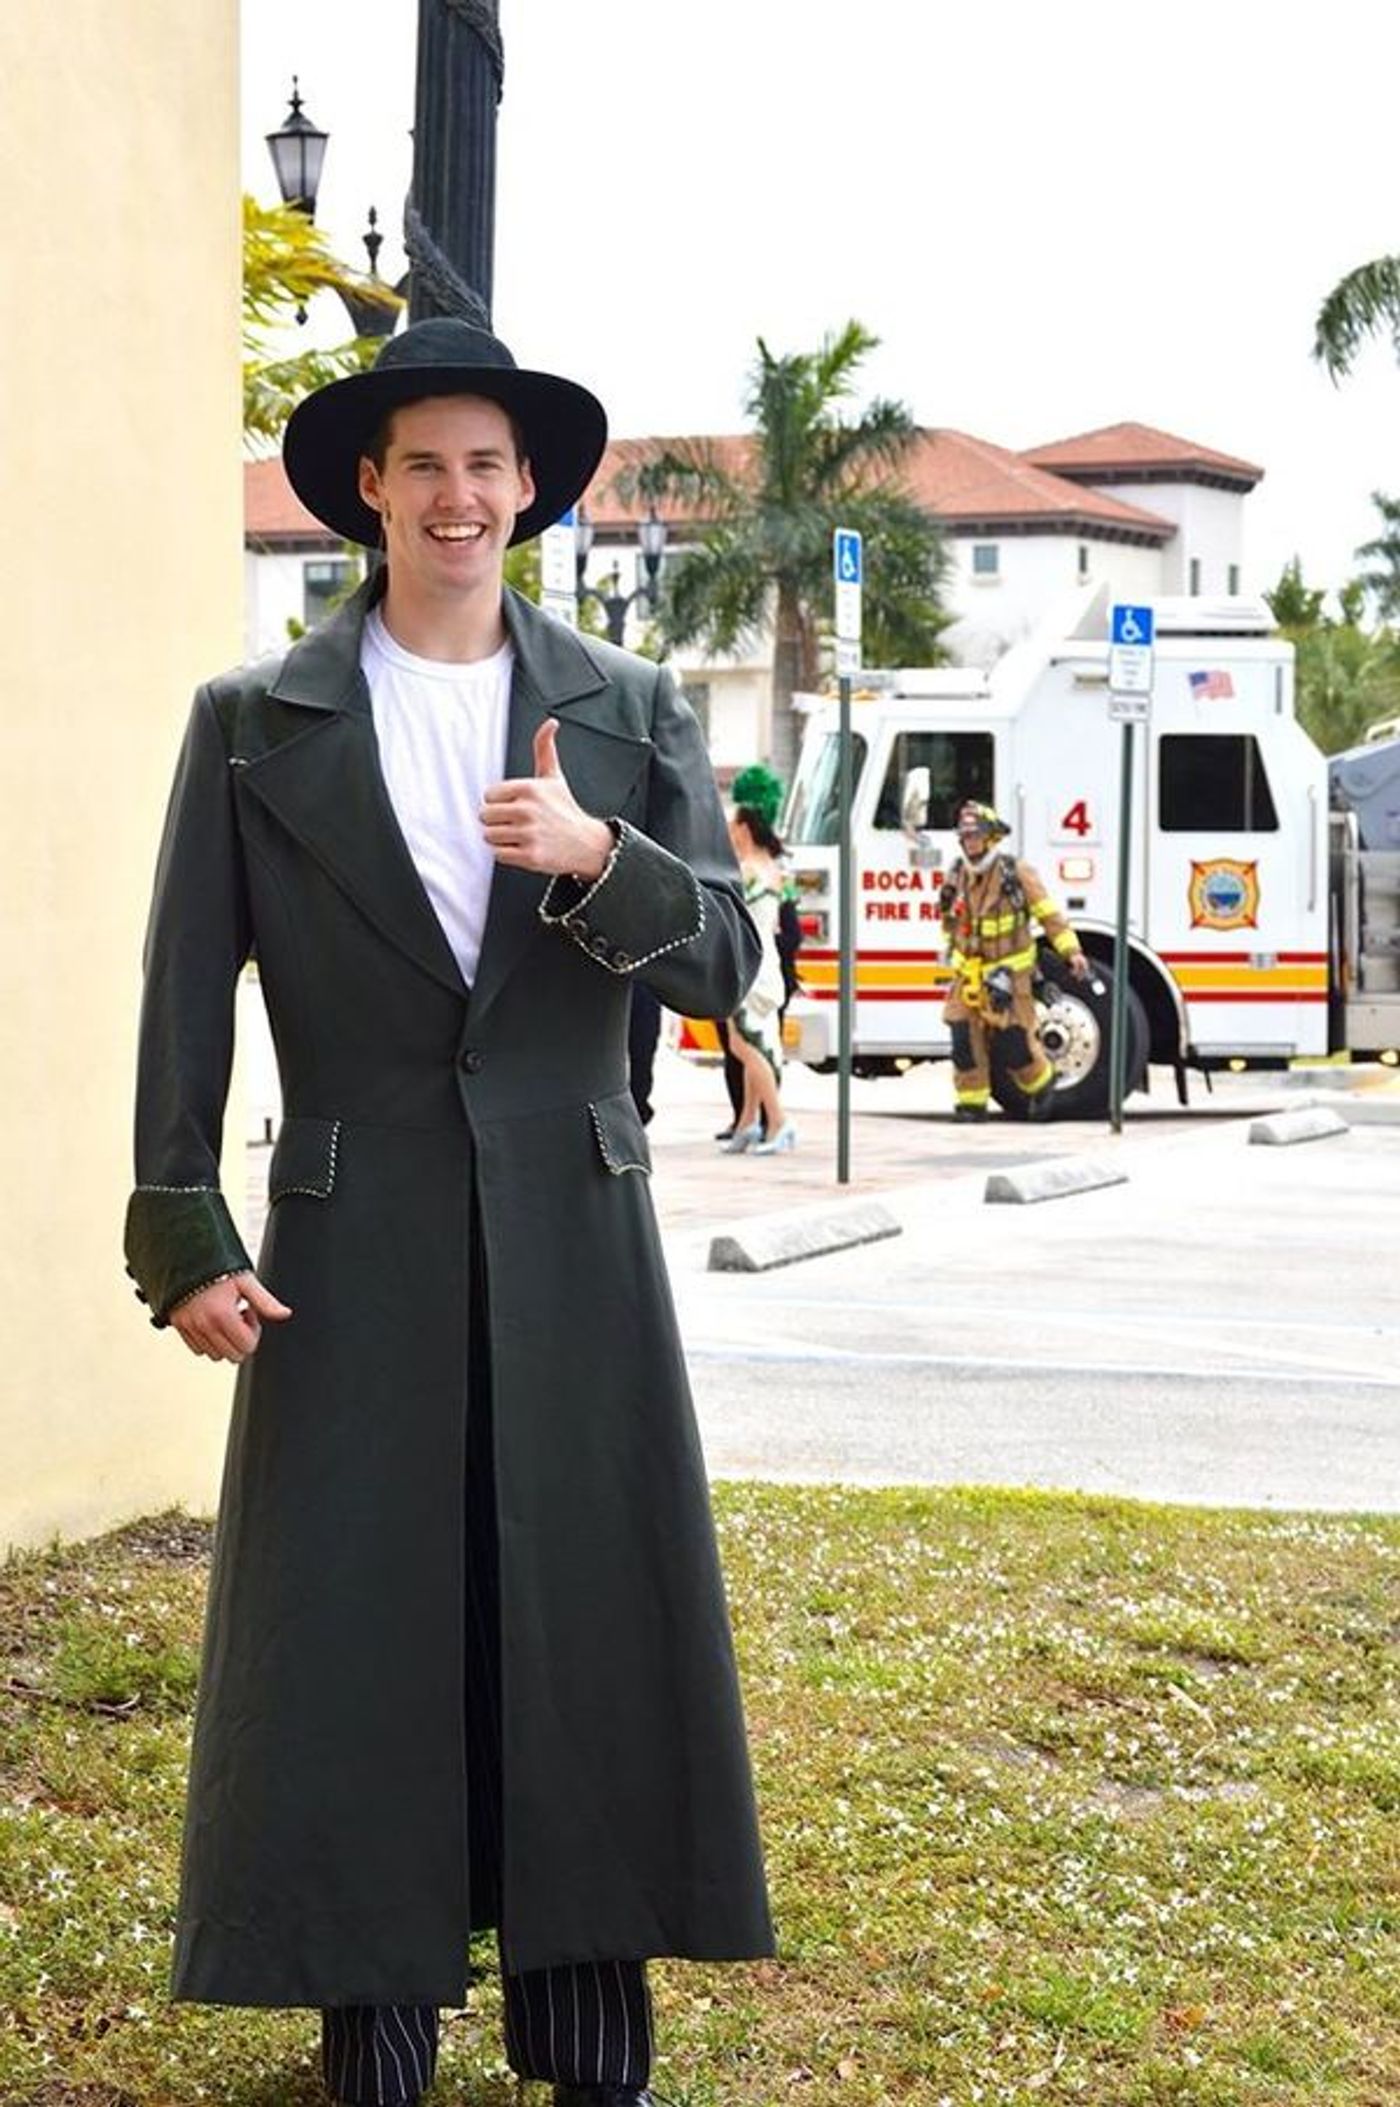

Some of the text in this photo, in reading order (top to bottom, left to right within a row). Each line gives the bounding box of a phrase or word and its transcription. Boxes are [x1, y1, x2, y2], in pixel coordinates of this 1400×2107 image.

[1062, 801, 1091, 836] 4
[862, 870, 924, 891] BOCA
[865, 902, 910, 920] FIRE
